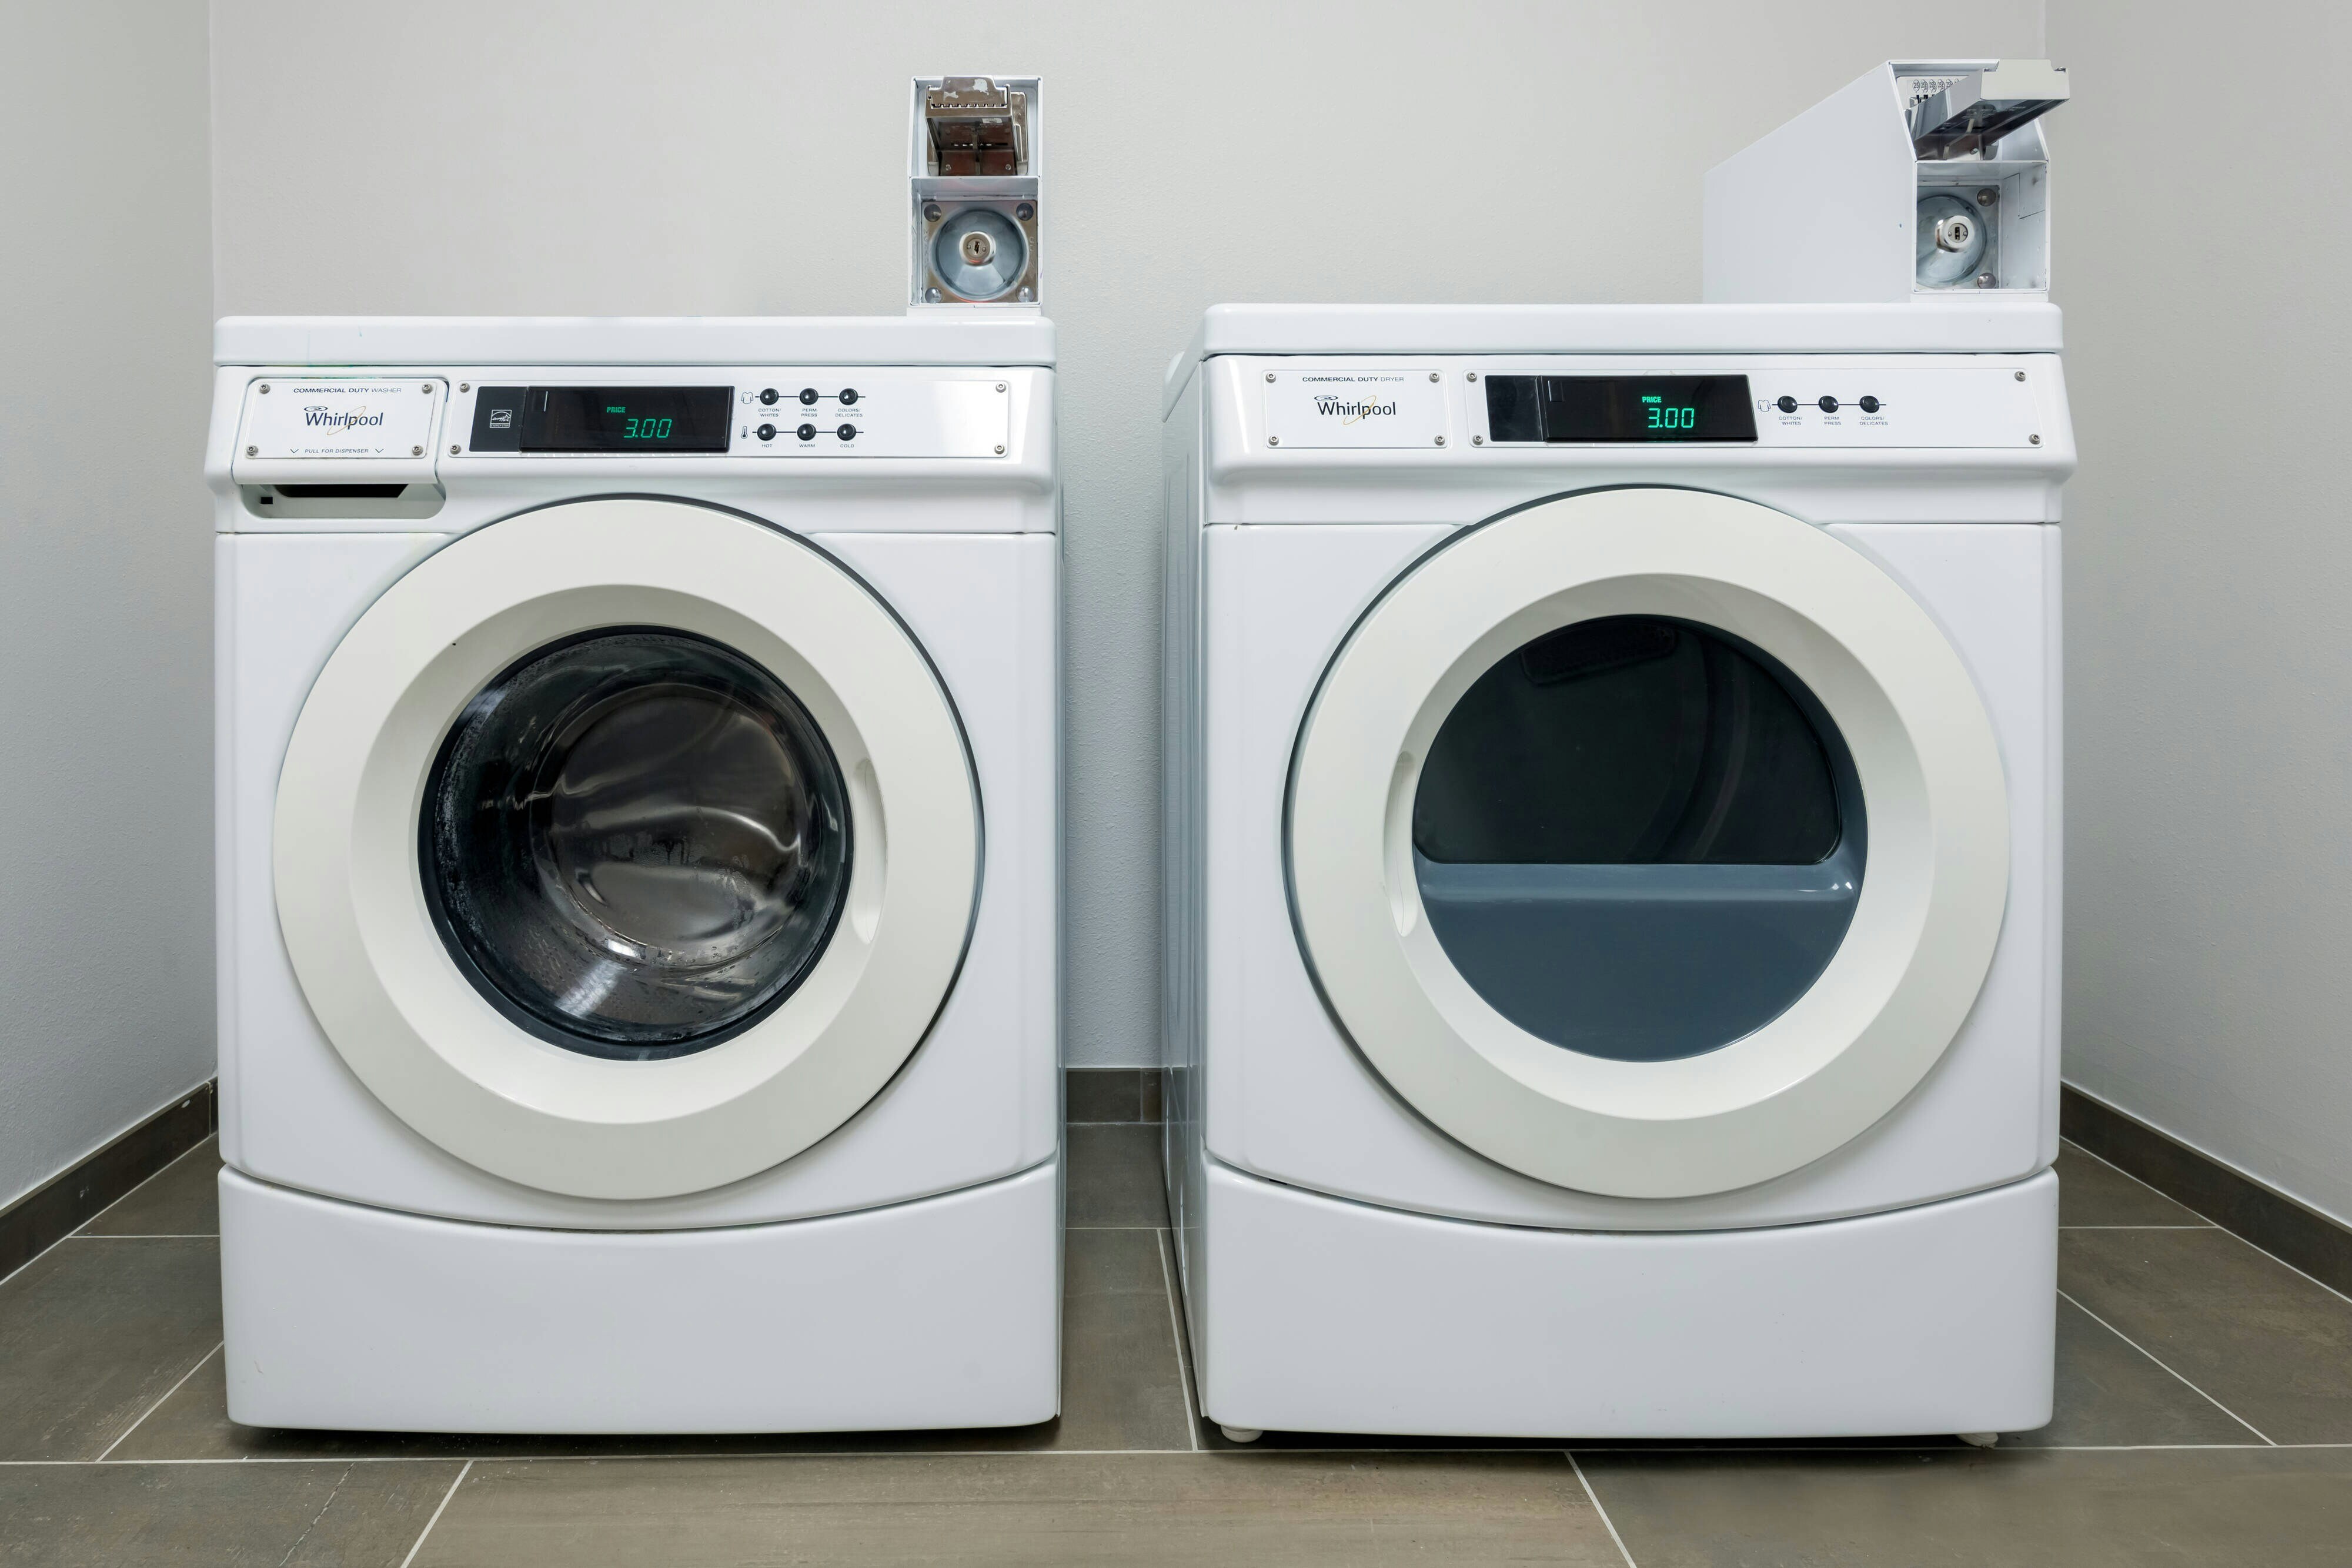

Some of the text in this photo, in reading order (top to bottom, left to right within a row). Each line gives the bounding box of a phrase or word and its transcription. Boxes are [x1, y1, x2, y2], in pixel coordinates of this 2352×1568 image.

[1318, 402, 1395, 419] Whirlpool
[1648, 408, 1694, 428] 3.00
[306, 413, 383, 430] Whirlpool
[624, 419, 671, 437] 3.00
